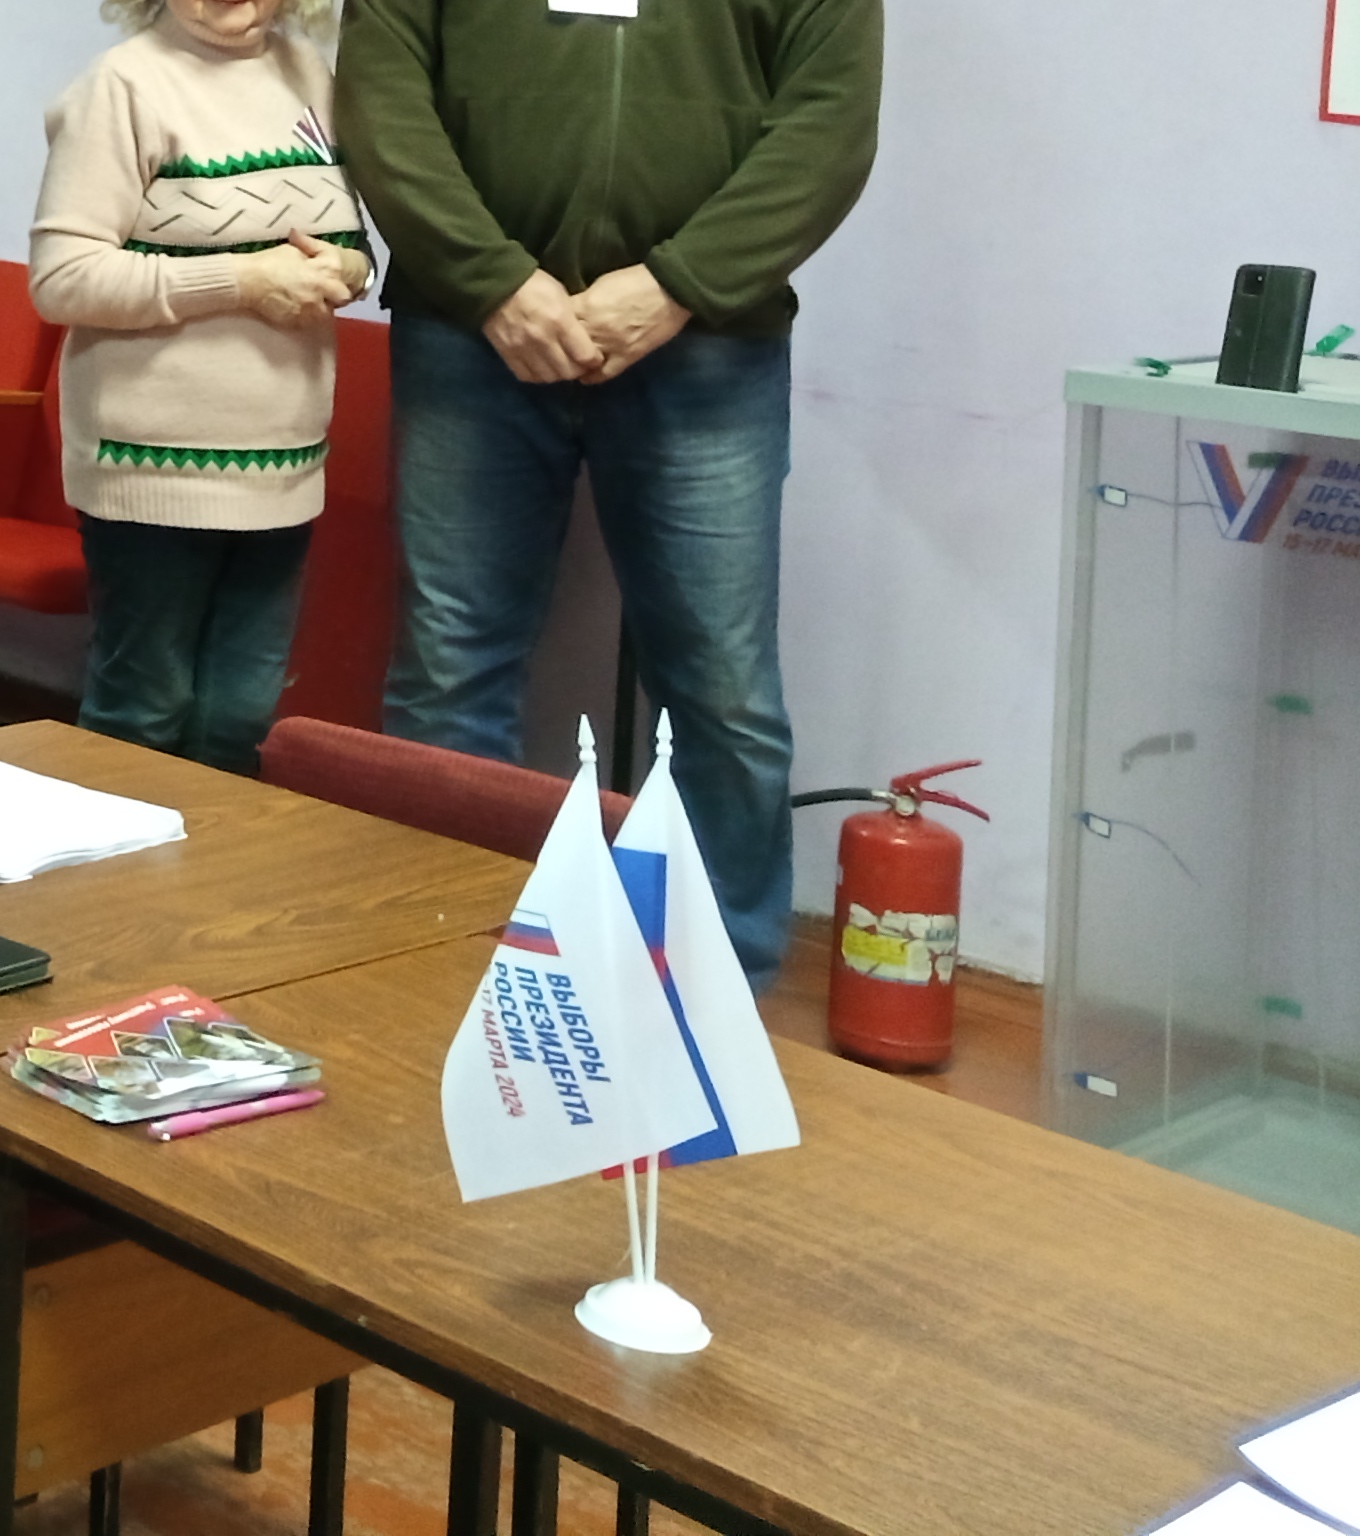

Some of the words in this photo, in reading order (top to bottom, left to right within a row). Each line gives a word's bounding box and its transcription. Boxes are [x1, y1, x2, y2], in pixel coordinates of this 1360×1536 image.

[1293, 509, 1360, 537] РОСС
[481, 1008, 509, 1070] МАРТА
[495, 1072, 525, 1118] 2024
[494, 961, 536, 1063] РОССИИ
[514, 966, 594, 1126] ПРЕЗИДЕНТА
[545, 971, 611, 1083] ВЫБОРЫ
